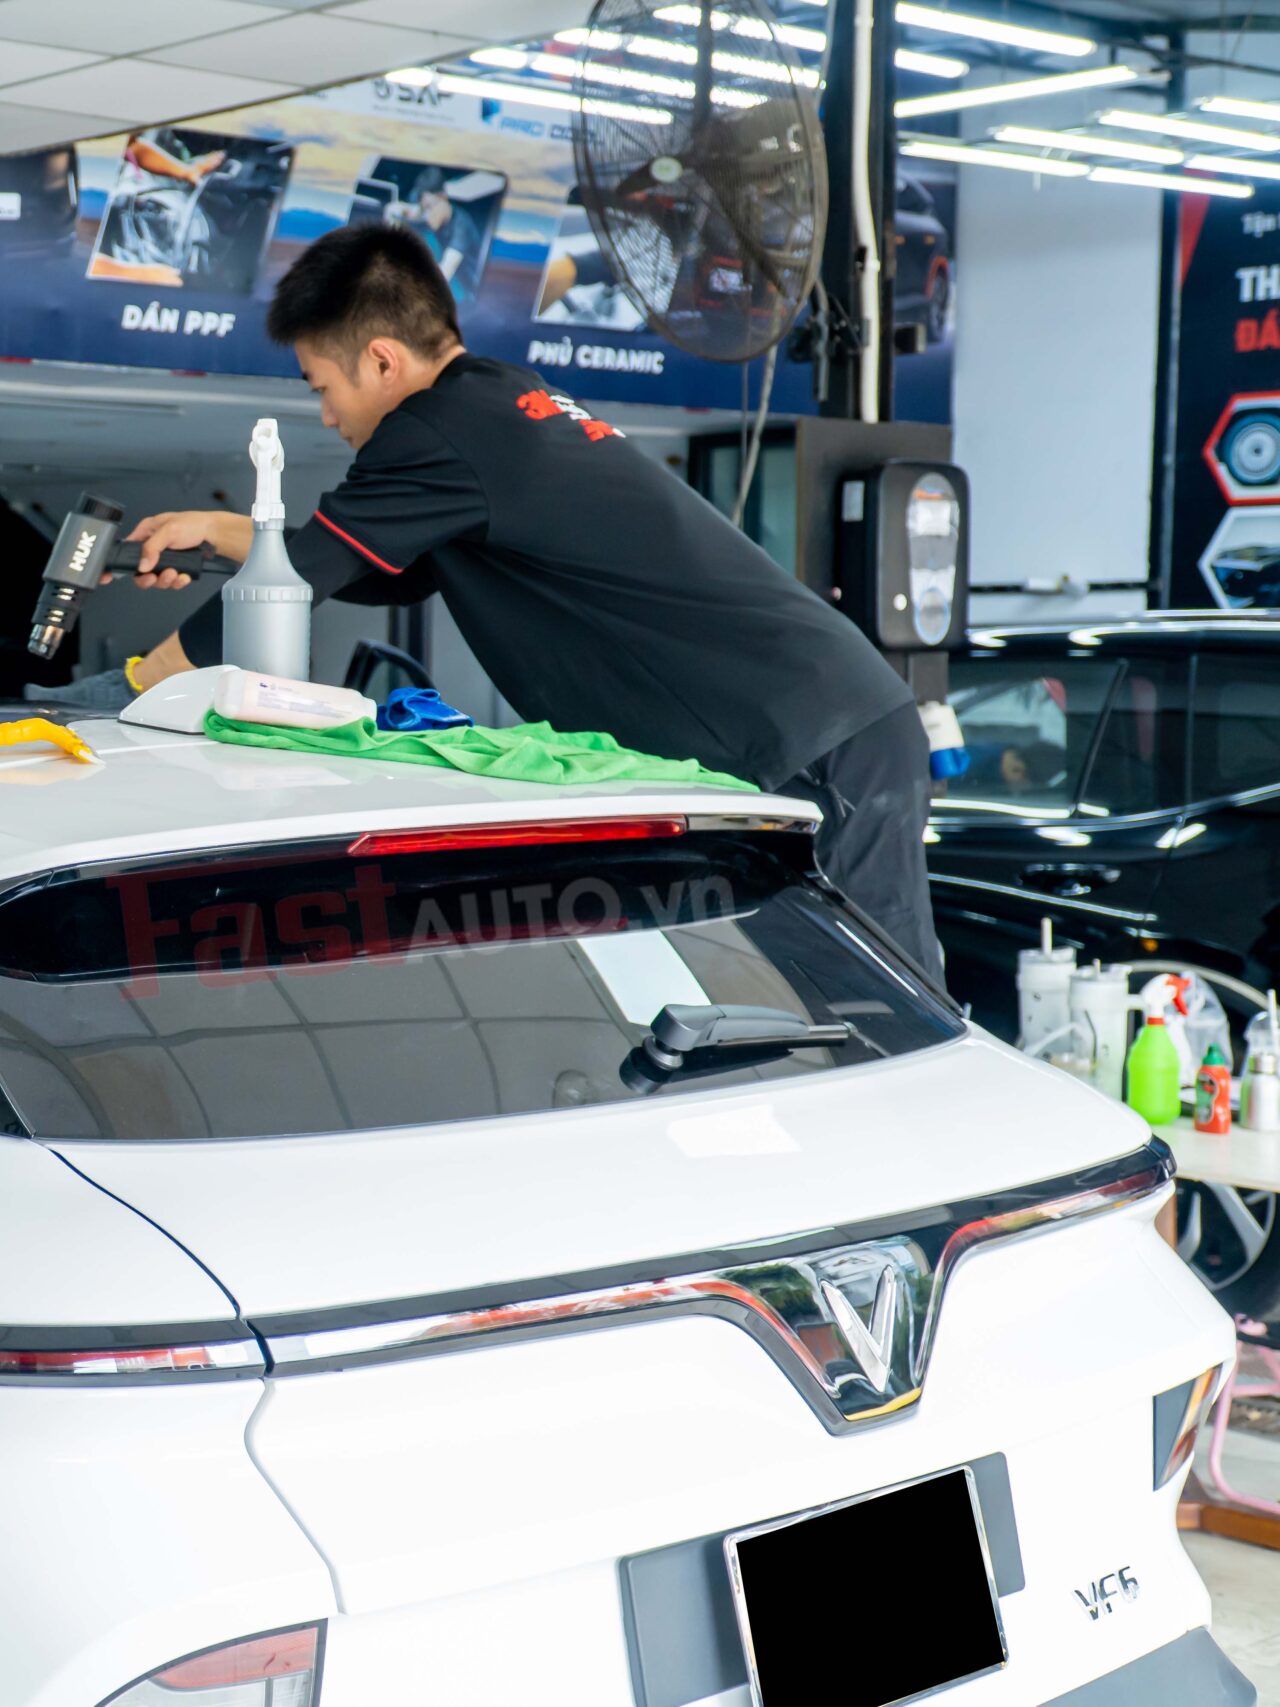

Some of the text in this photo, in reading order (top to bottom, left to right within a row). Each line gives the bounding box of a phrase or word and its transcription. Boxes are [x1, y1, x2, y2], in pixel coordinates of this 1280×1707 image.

[183, 310, 236, 338] PPF
[575, 344, 665, 375] CERAMIC
[69, 531, 97, 572] HUK
[1072, 1565, 1140, 1621] VF6
